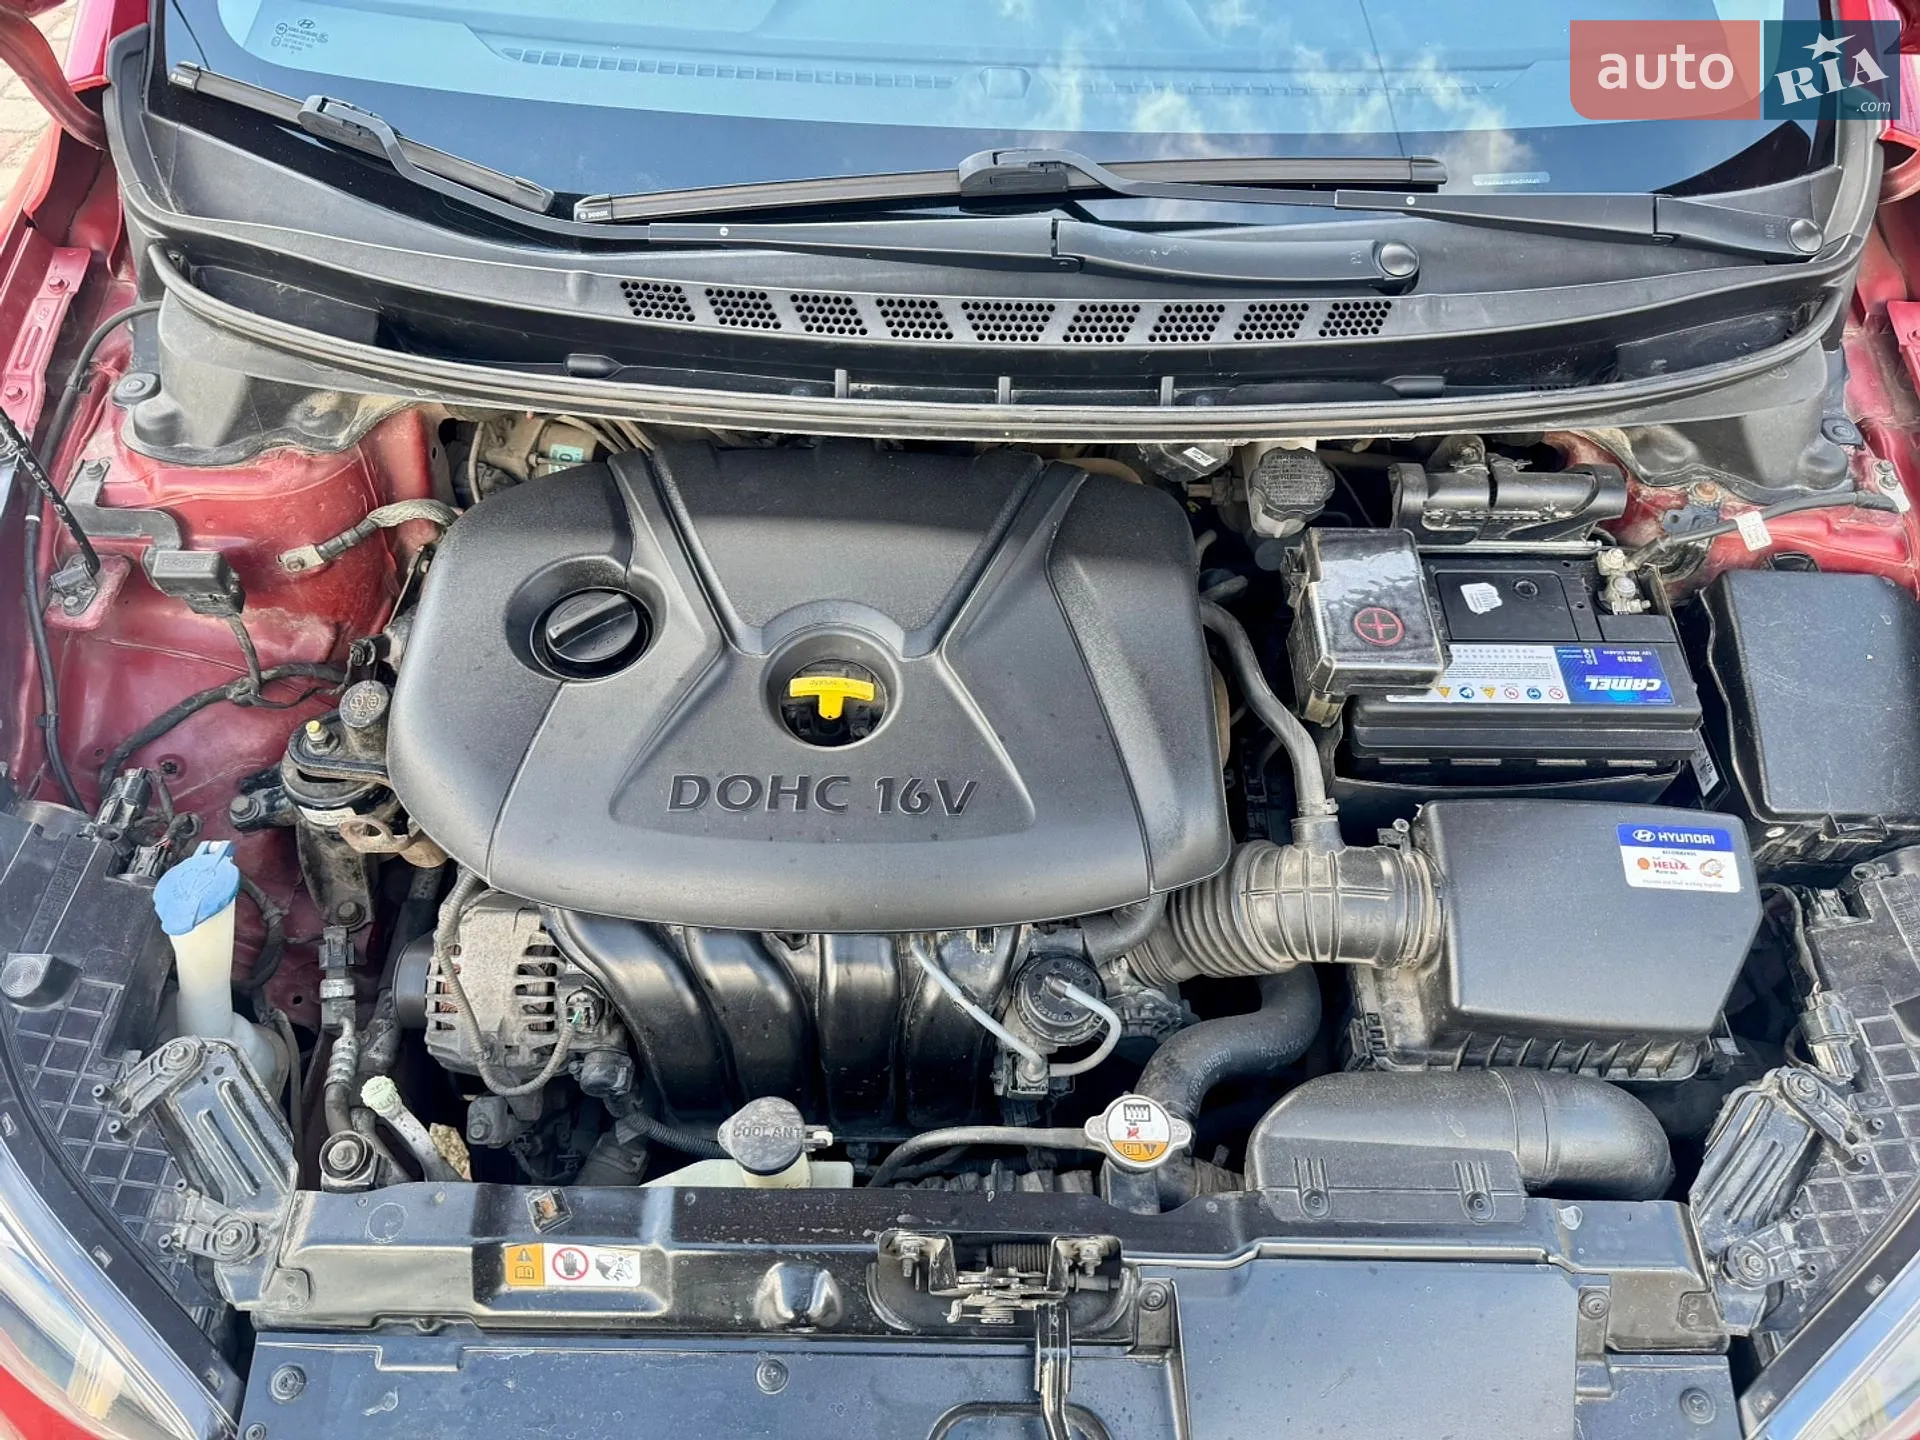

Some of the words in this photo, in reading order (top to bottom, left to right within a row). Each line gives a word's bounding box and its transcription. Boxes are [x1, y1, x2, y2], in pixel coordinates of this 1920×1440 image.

[1585, 678, 1662, 691] CAMEL
[667, 774, 851, 813] DOHC
[874, 776, 978, 816] 16V
[1658, 831, 1716, 845] HYUNDAI
[1653, 861, 1688, 870] HELIX
[733, 1126, 801, 1138] COOLANT
